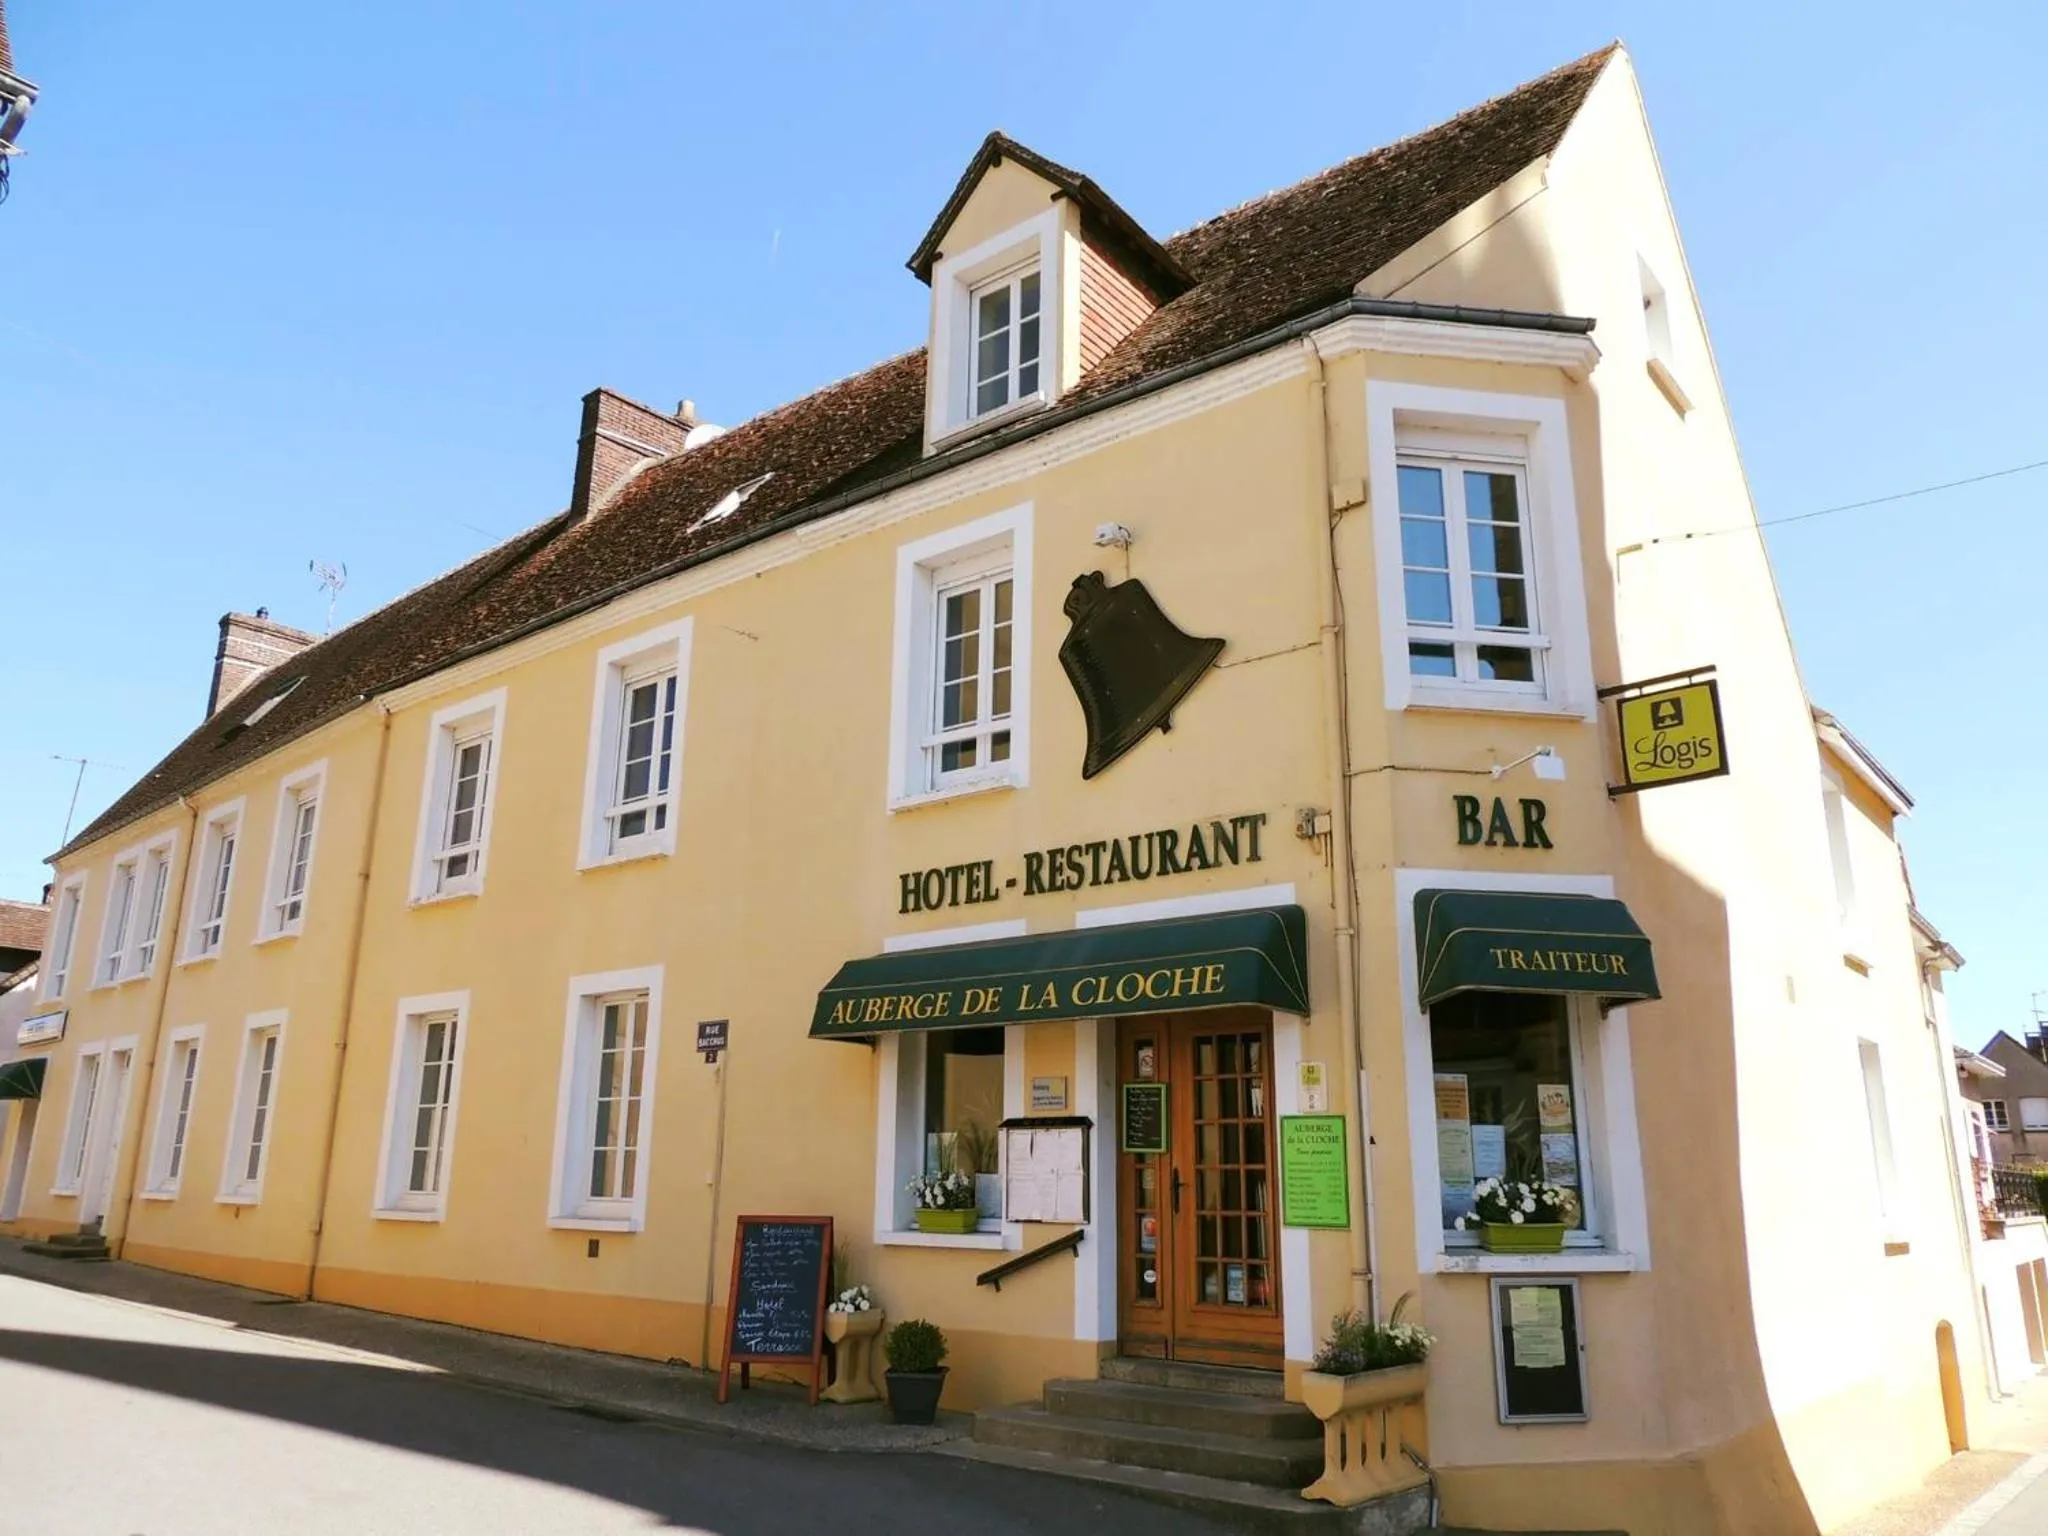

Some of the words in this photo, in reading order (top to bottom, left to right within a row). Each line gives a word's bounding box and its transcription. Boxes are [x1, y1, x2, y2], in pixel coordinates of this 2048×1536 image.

[1634, 731, 1713, 770] Logis
[1453, 794, 1554, 850] BAR
[898, 860, 999, 914] HOTEL
[1022, 813, 1267, 897] RESTAURANT
[1490, 947, 1629, 976] TRAITEUR
[827, 990, 953, 1026] AUBERGE
[959, 986, 1003, 1016] DE
[1017, 979, 1059, 1011] LA
[1070, 964, 1226, 1007] CLOCHE
[1294, 1123, 1334, 1134] AUBERGE
[1305, 1134, 1341, 1145] CLOCHE
